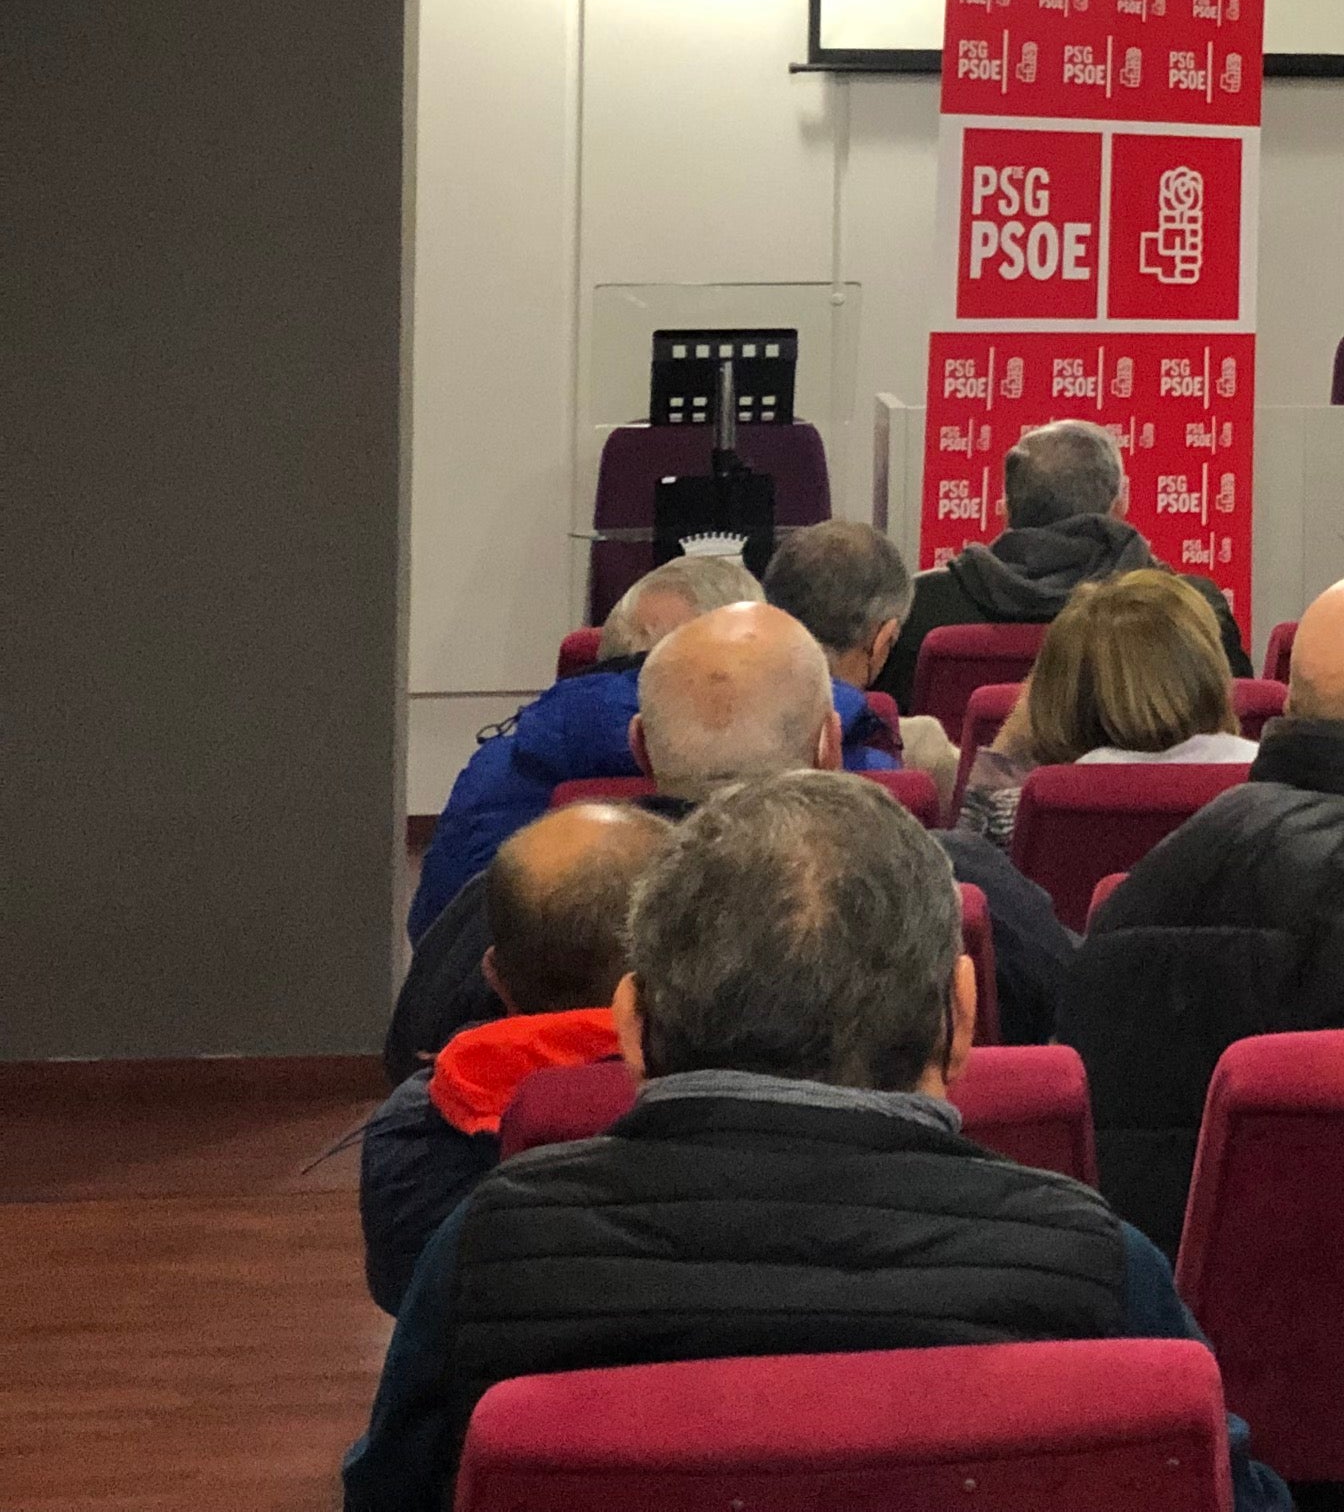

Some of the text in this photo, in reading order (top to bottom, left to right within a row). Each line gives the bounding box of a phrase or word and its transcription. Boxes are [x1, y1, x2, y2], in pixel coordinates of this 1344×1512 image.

[958, 40, 988, 59] PSG
[1064, 46, 1092, 64] PSG
[958, 59, 1001, 80] PSOE
[1169, 51, 1195, 69] PSG
[1063, 64, 1105, 85] PSOE
[1169, 69, 1206, 90] PSOE
[969, 221, 1091, 280] PSOE
[945, 359, 975, 377] PSG
[1053, 359, 1083, 376] PSG
[1161, 359, 1190, 376] PSG
[944, 377, 987, 399] PSOE
[1052, 376, 1096, 397] PSOE
[1160, 376, 1204, 396] PSOE
[939, 481, 968, 499] PSG
[1158, 476, 1187, 493] PSG
[938, 498, 981, 520] PSOE
[1157, 492, 1200, 513] PSOE
